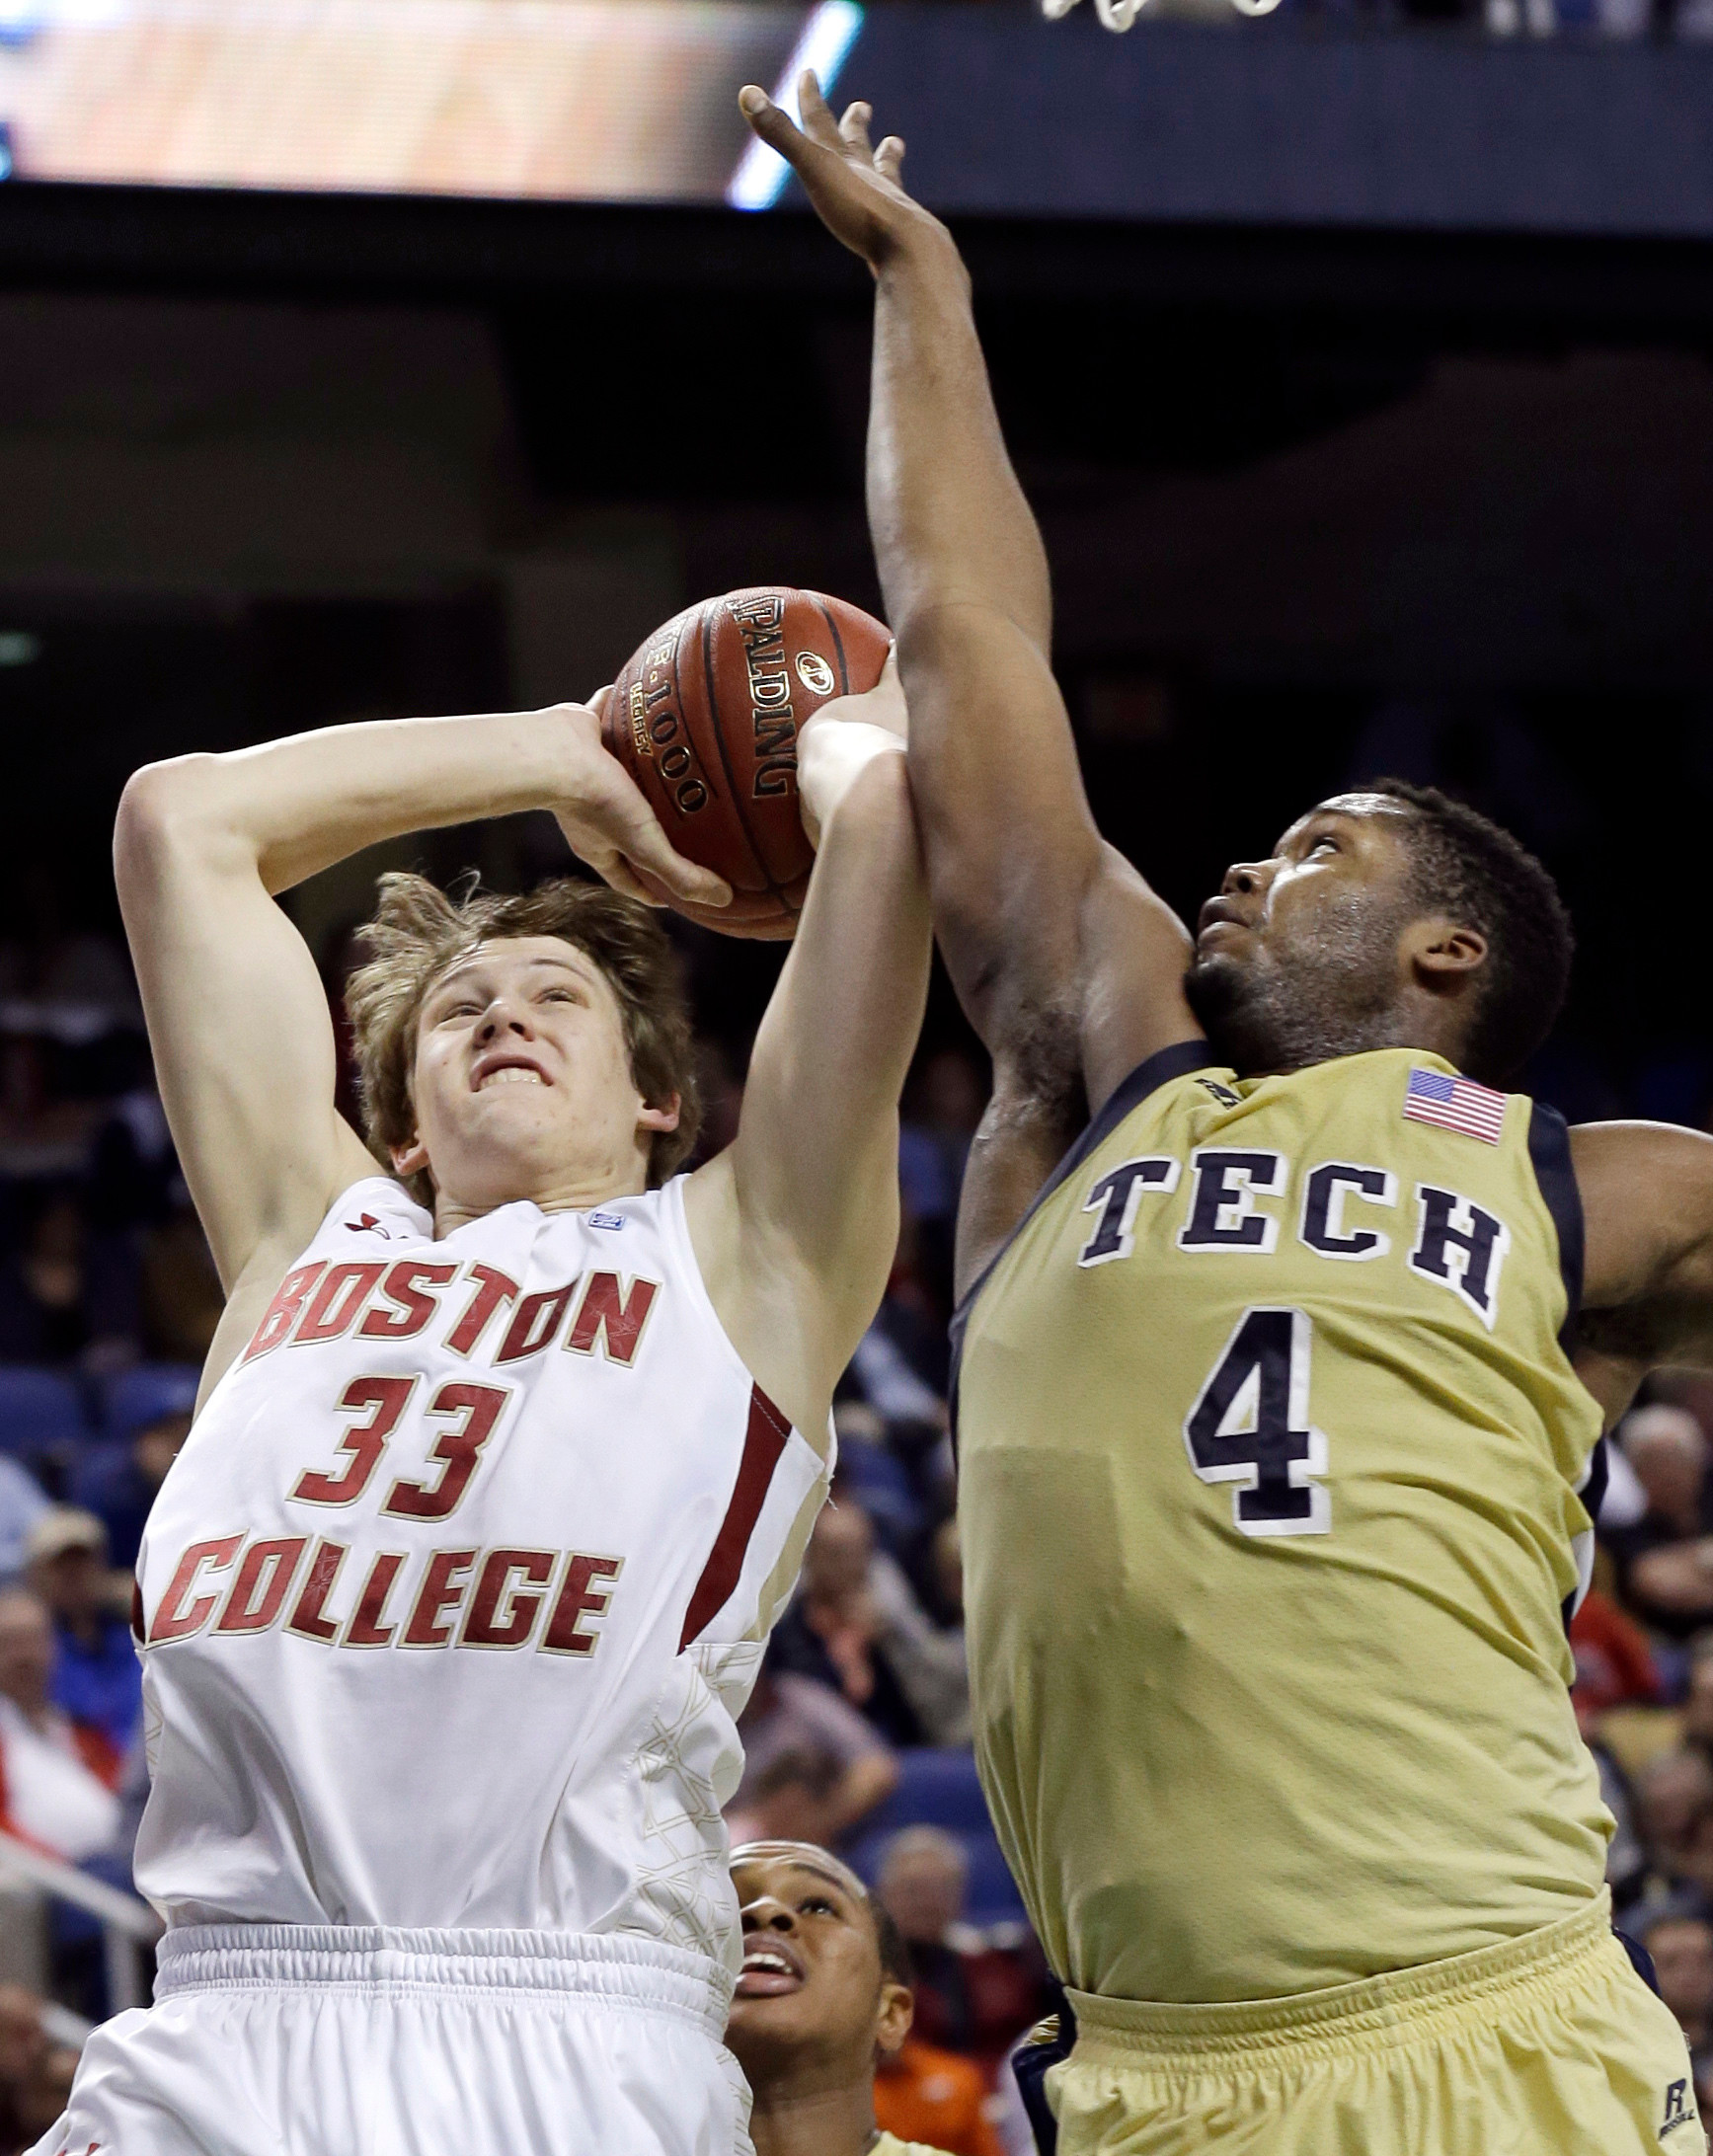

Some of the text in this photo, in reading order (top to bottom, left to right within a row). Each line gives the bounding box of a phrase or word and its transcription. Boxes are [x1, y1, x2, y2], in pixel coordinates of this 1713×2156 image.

[1077, 1147, 1512, 1332] TECH
[236, 1259, 662, 1370] BOSTON
[285, 1373, 513, 1522] 33
[1183, 1305, 1332, 1537] 4
[143, 1529, 625, 1658] COLLEGE
